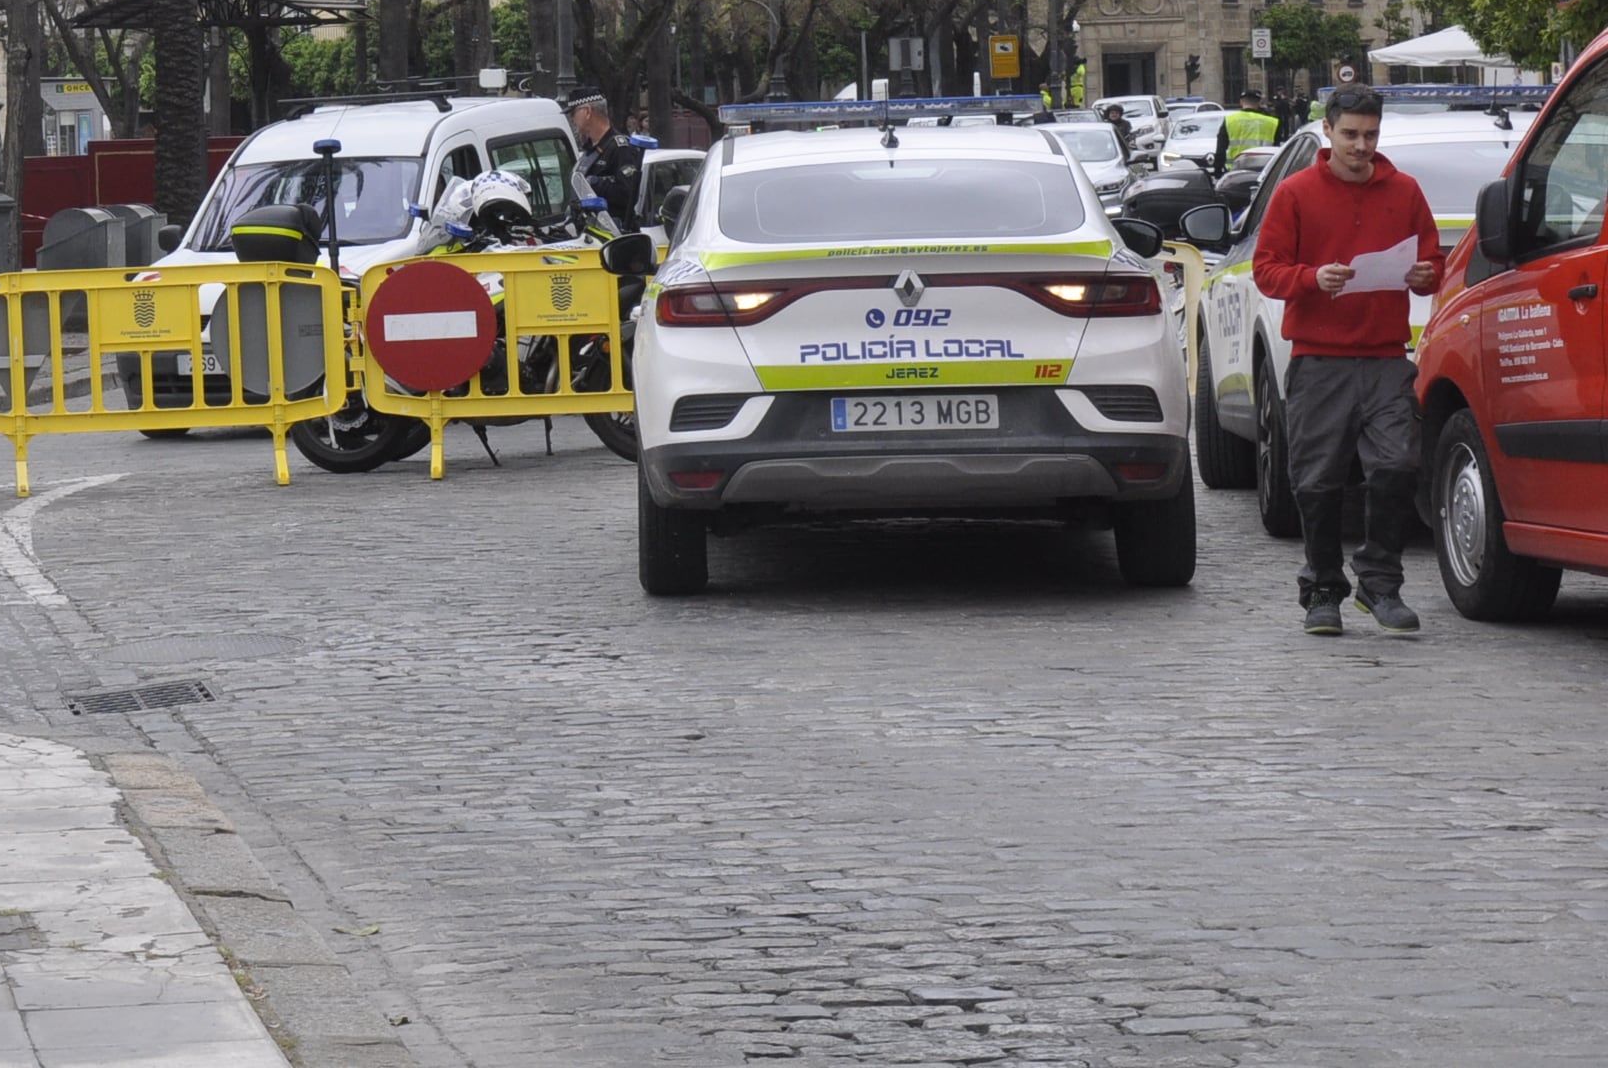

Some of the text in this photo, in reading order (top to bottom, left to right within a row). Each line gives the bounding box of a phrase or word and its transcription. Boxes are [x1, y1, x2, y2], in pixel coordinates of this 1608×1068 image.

[893, 308, 952, 327] 092
[799, 334, 1024, 363] POLICÍA LOCAL
[885, 367, 939, 379] JEREZ
[1034, 364, 1063, 379] 112
[853, 399, 991, 427] 2213 MGB
